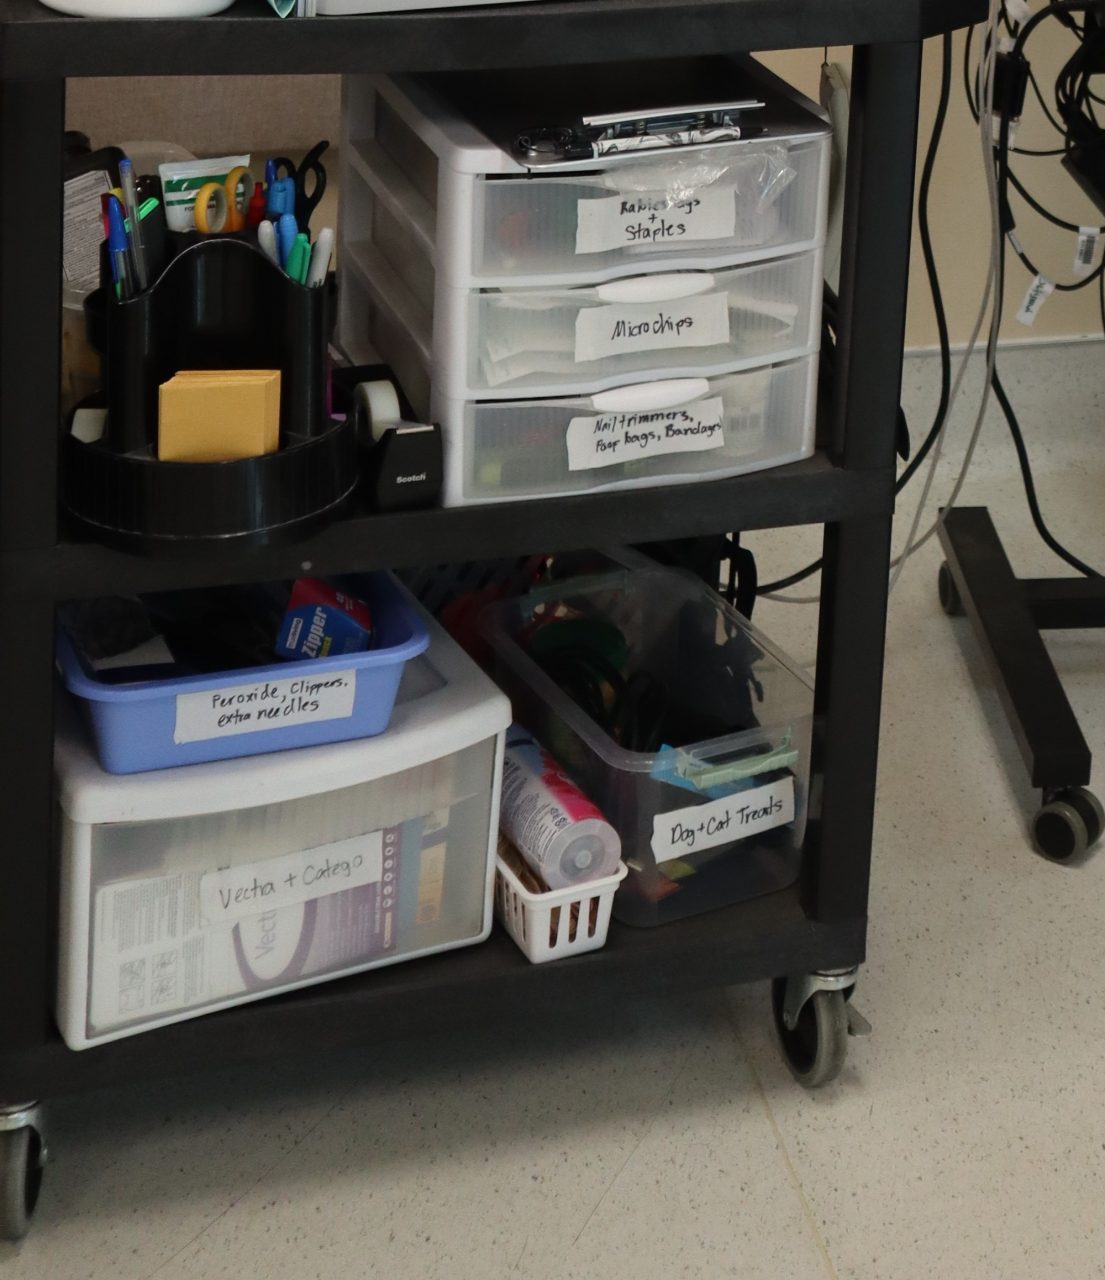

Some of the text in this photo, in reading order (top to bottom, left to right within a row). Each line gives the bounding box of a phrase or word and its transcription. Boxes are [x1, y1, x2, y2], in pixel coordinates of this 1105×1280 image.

[625, 219, 686, 243] Staples
[611, 312, 694, 340] Microchips
[396, 472, 427, 484] Scotch
[301, 606, 328, 658] Zipper
[212, 683, 288, 709] Peroxide,
[217, 697, 319, 728] extra needles
[736, 795, 783, 825] Treats
[219, 854, 363, 910] Vectra + Catego
